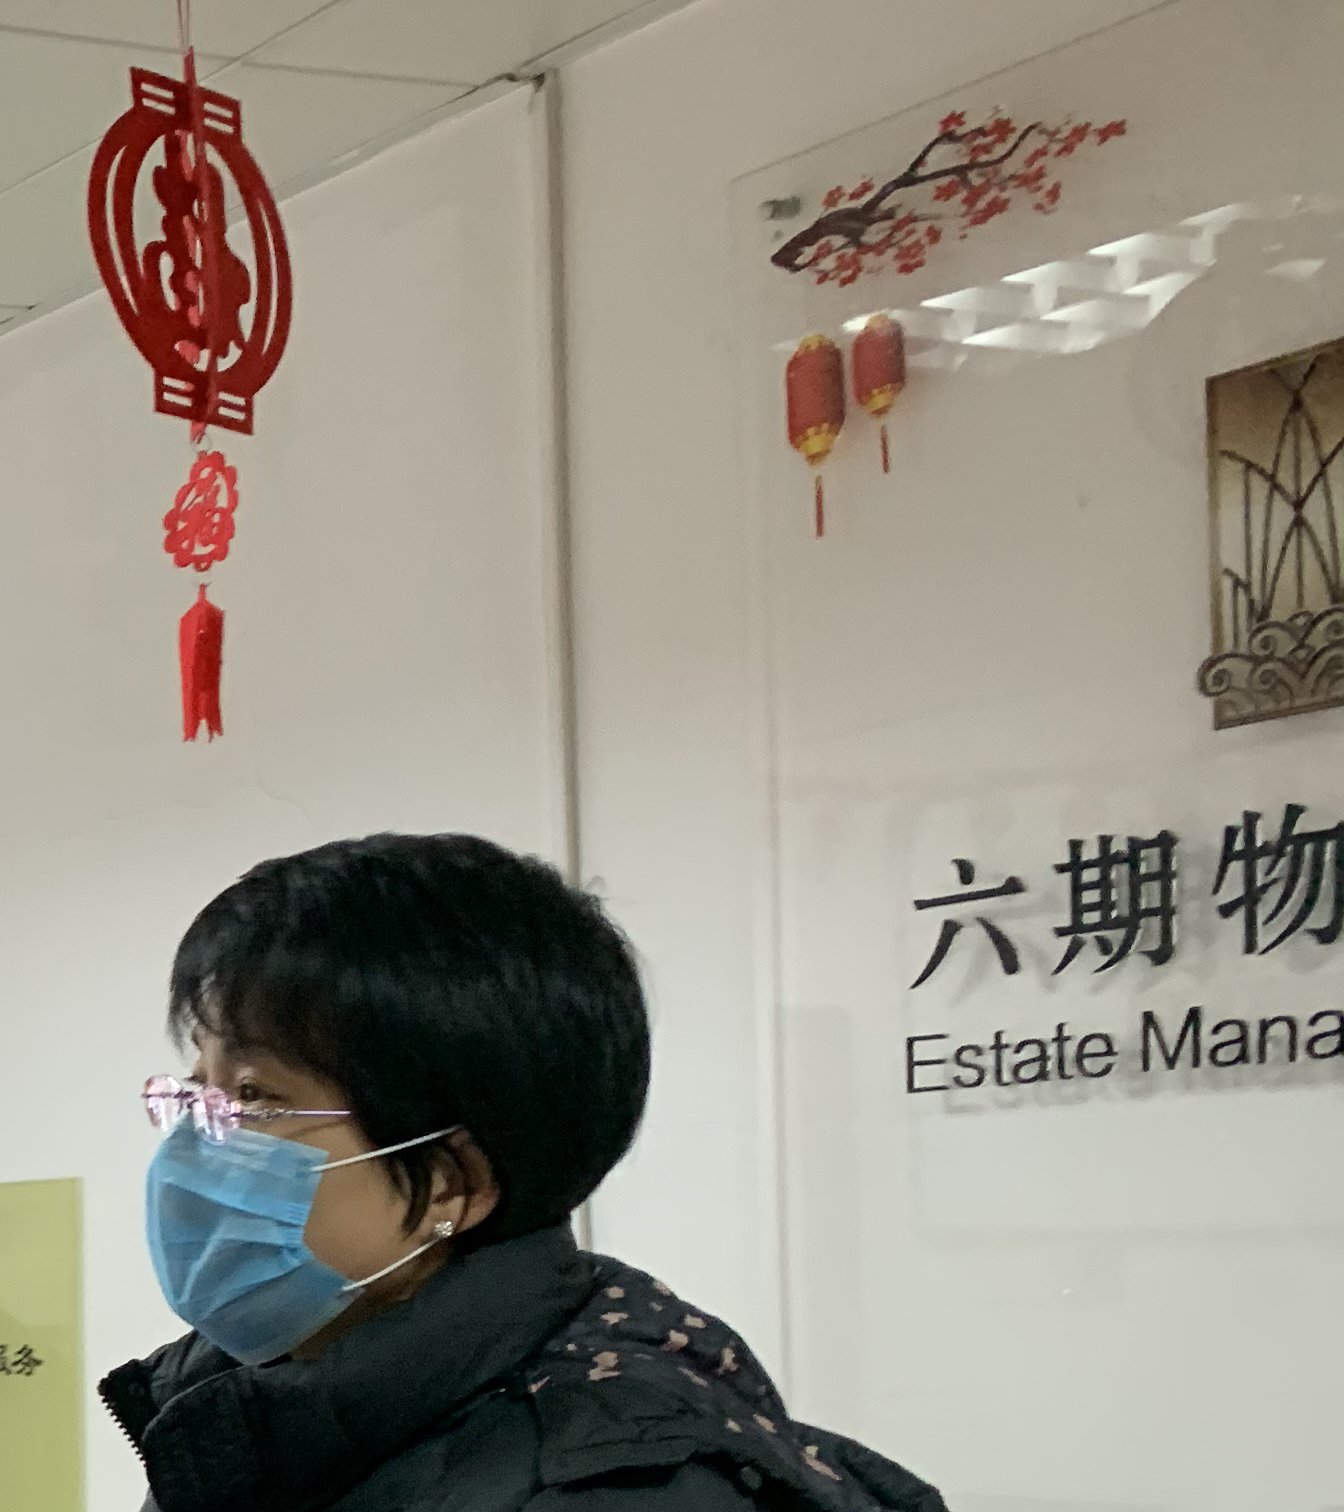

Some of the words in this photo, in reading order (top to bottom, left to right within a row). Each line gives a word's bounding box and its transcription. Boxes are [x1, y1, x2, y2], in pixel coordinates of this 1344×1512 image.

[909, 803, 1344, 990] 六期物
[906, 1021, 1119, 1094] Estate
[1140, 1006, 1344, 1072] Mana
